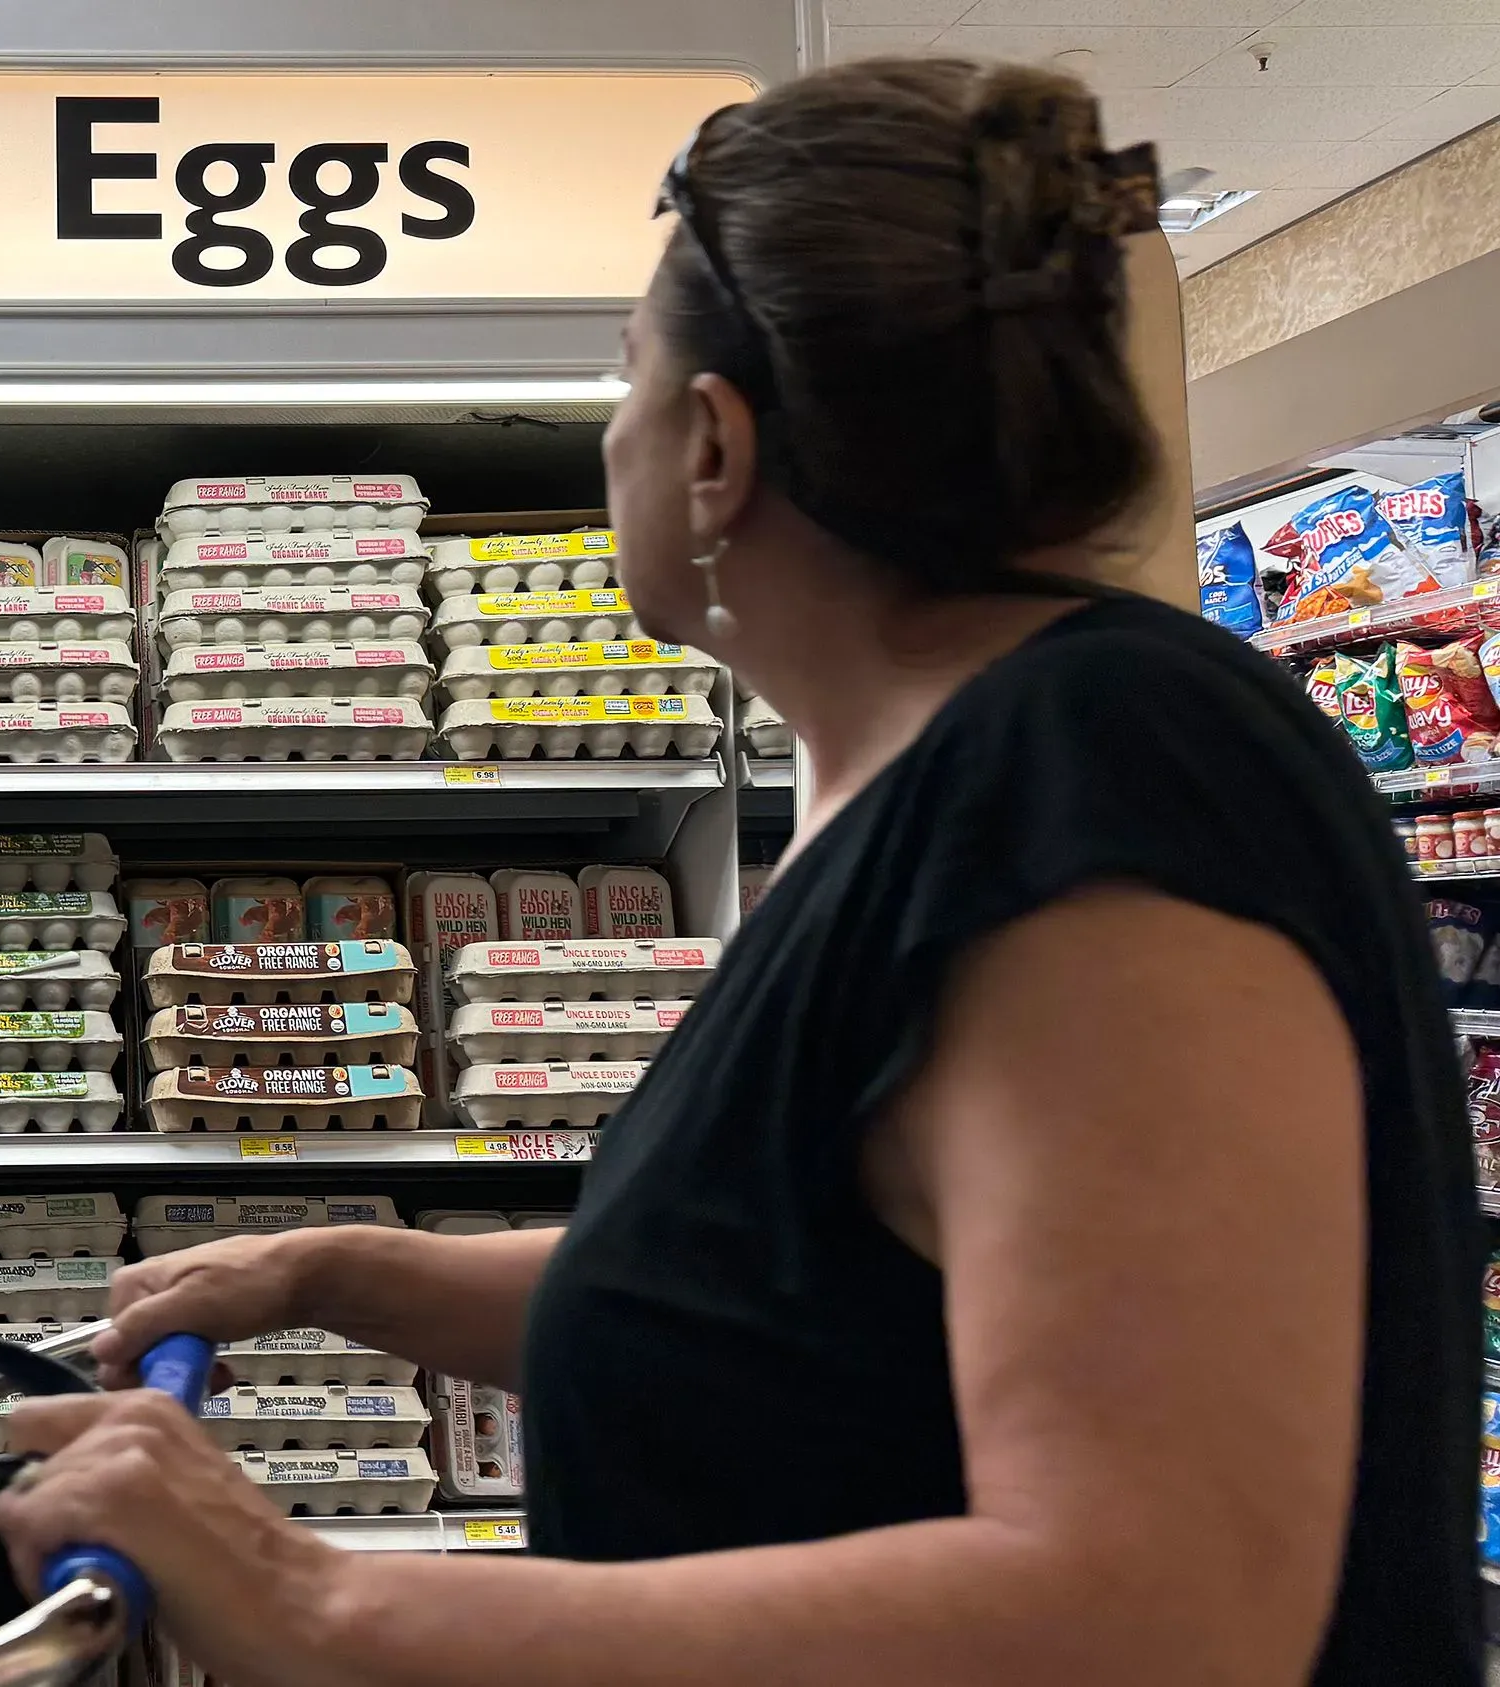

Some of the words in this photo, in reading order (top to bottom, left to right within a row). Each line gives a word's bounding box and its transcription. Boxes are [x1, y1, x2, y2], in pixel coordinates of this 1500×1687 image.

[54, 96, 477, 288] Eggs
[198, 488, 216, 497] FREE
[219, 487, 245, 496] RANGE
[1408, 704, 1452, 729] wavy
[519, 888, 569, 902] UNCLE
[608, 886, 659, 898] UNCLE
[434, 893, 484, 906] UNCLE
[522, 916, 547, 928] WILD
[550, 917, 572, 929] HEN
[611, 913, 637, 925] WILD
[641, 914, 662, 925] HEN
[437, 921, 463, 932] WILD
[466, 920, 487, 932] HEN
[257, 946, 318, 957] ORGANIC
[490, 953, 511, 964] FREE
[513, 951, 539, 963] RANGE
[562, 950, 590, 958] UNCLE
[592, 950, 627, 958] EDDIE'S
[210, 954, 252, 968] CLOVER
[259, 957, 284, 969] FREE
[286, 957, 319, 969] RANGE
[260, 1007, 321, 1018] ORGANIC
[493, 1012, 516, 1024] FREE
[517, 1011, 542, 1024] RANGE
[566, 1011, 594, 1019] UNCLE
[596, 1011, 630, 1019] EDDIE'S
[213, 1017, 255, 1031] CLOVER
[262, 1019, 288, 1031] FREE
[289, 1019, 322, 1031] RANGE
[263, 1069, 325, 1081] ORGANIC
[497, 1074, 518, 1086] FREE
[519, 1073, 546, 1086] RANGE
[571, 1071, 599, 1079] UNCLE
[216, 1080, 258, 1093] CLOVER
[266, 1082, 291, 1094] FREE
[293, 1081, 326, 1094] RANGE
[509, 1134, 555, 1148] NCLE
[204, 1400, 229, 1415] RANGE
[455, 1393, 467, 1425] JUMBO
[498, 1525, 516, 1534] 5.48
